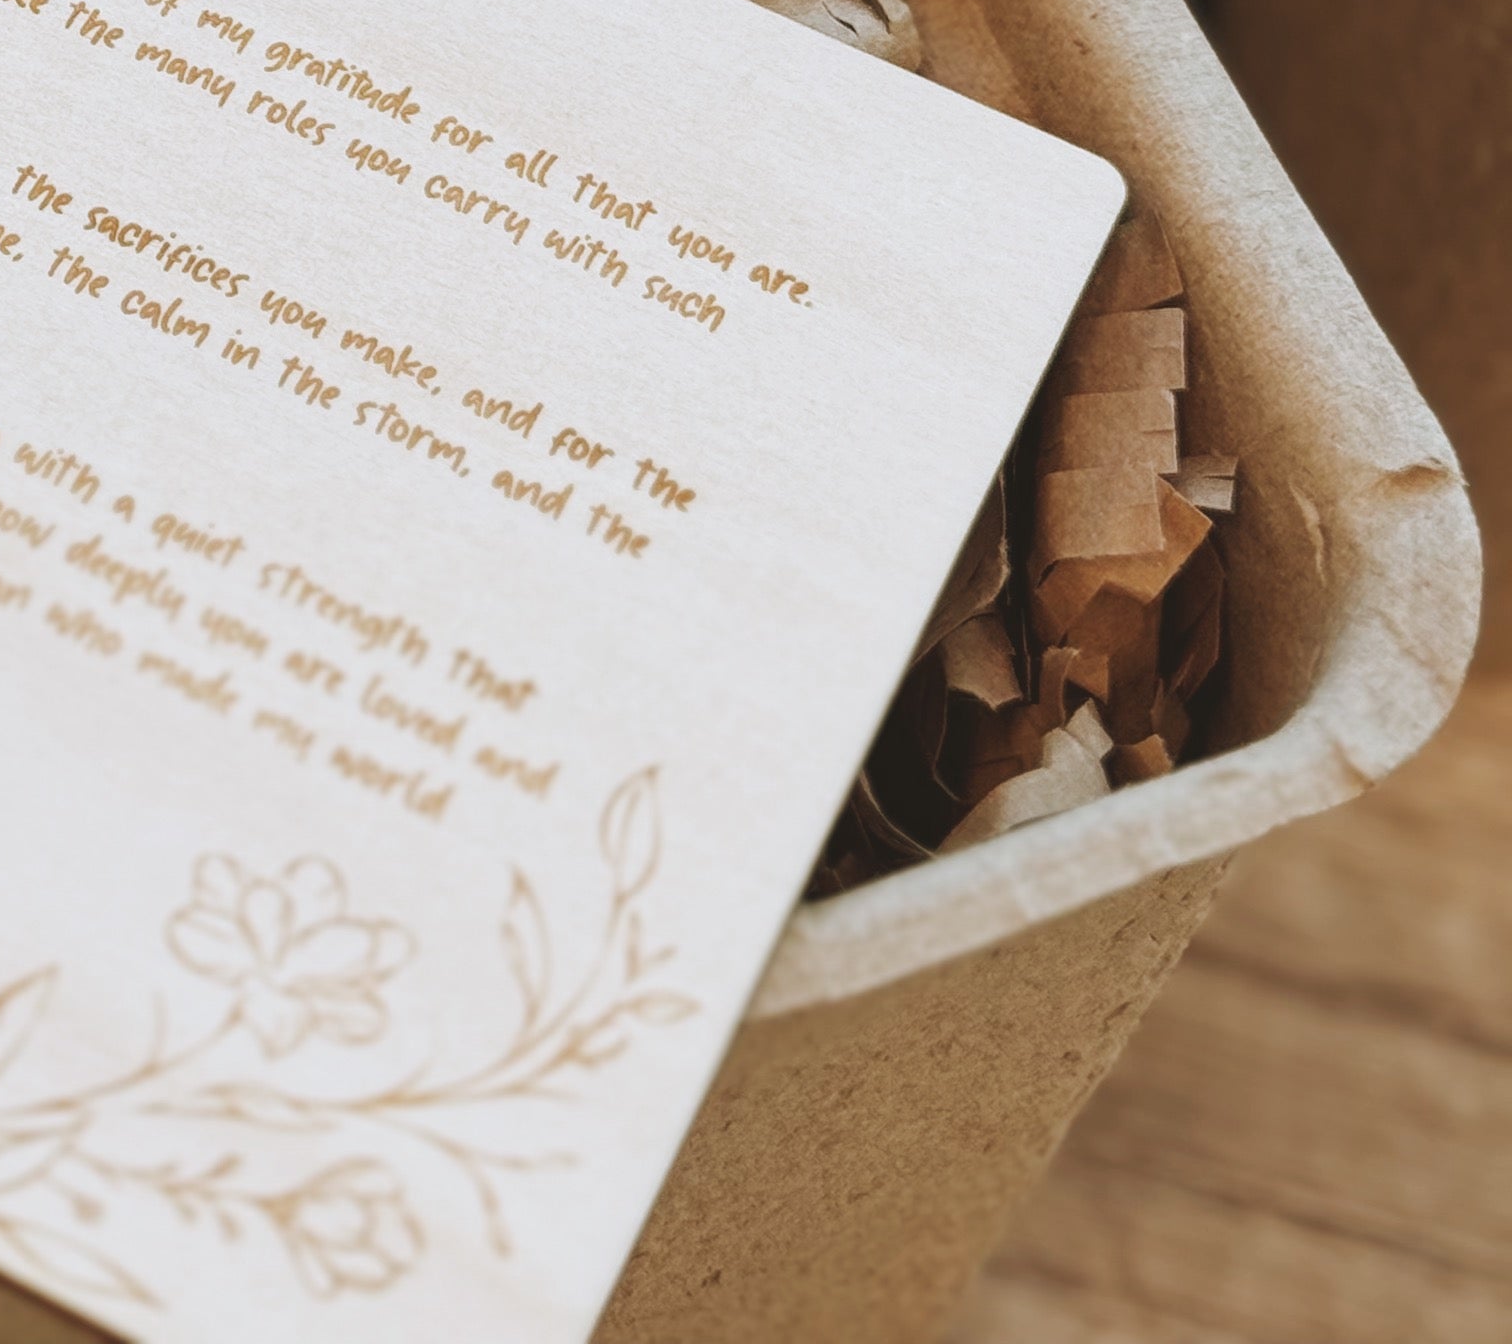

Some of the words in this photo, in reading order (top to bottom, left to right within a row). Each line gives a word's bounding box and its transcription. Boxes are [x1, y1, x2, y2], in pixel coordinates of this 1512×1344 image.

[64, 1, 124, 47] the
[135, 42, 236, 107] many
[246, 90, 334, 145] roles
[344, 138, 412, 184] you
[424, 175, 530, 244] carry
[543, 229, 629, 287] with
[643, 275, 726, 333] such
[196, 9, 254, 53] my
[264, 41, 421, 124] gratitude
[430, 115, 493, 153] for
[504, 148, 558, 188] all
[573, 172, 656, 230] that
[667, 224, 737, 270] you
[748, 263, 811, 307] are.
[12, 164, 72, 214] the
[83, 205, 249, 297] sacrifices
[258, 289, 328, 339] you
[339, 328, 440, 395] make,
[461, 387, 545, 439] and
[548, 426, 614, 469] for
[633, 457, 696, 511] the
[47, 246, 109, 298] the
[120, 289, 211, 346] calm
[221, 329, 261, 368] in
[279, 355, 341, 408] the
[354, 401, 468, 476] storm,
[491, 468, 575, 518] and
[587, 502, 652, 559] the
[14, 442, 100, 503] with
[111, 495, 136, 522] a
[151, 512, 245, 565] quiet
[259, 562, 430, 663] strength
[450, 647, 538, 712] that
[45, 603, 124, 655] who
[136, 651, 238, 713] made
[253, 710, 316, 759] my
[330, 745, 455, 821] world
[65, 535, 185, 619] deeply
[200, 607, 269, 657] you
[284, 650, 344, 693] are
[361, 676, 465, 753] loved
[473, 746, 559, 797] and
